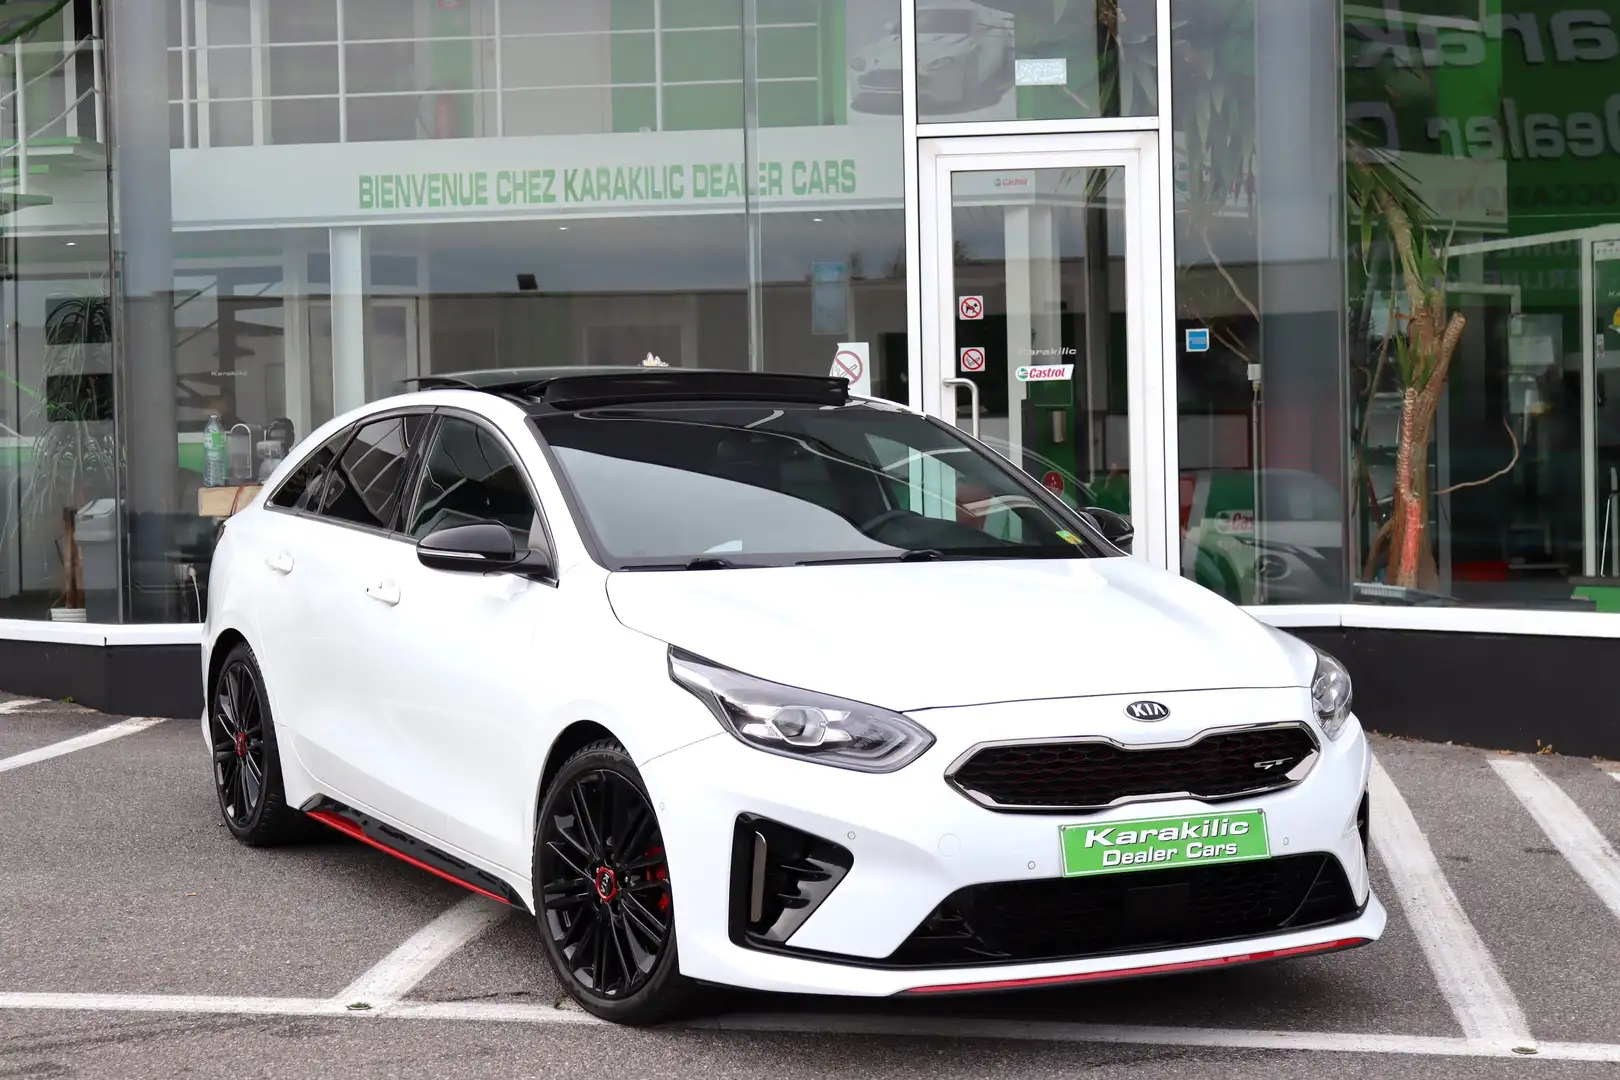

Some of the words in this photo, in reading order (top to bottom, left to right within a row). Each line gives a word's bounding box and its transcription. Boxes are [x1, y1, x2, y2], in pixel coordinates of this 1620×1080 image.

[359, 171, 488, 209] BIENVENUE
[496, 169, 556, 205] CHEZ
[564, 164, 684, 203] KARAKILIC
[693, 161, 783, 198] DEALER
[792, 159, 857, 196] CARS
[1029, 367, 1066, 379] Castrol
[1131, 703, 1167, 717] KIA
[1253, 756, 1294, 770] GT
[1085, 818, 1250, 848] Karakilic
[1102, 846, 1178, 867] Dealer
[1186, 842, 1238, 860] Cars
